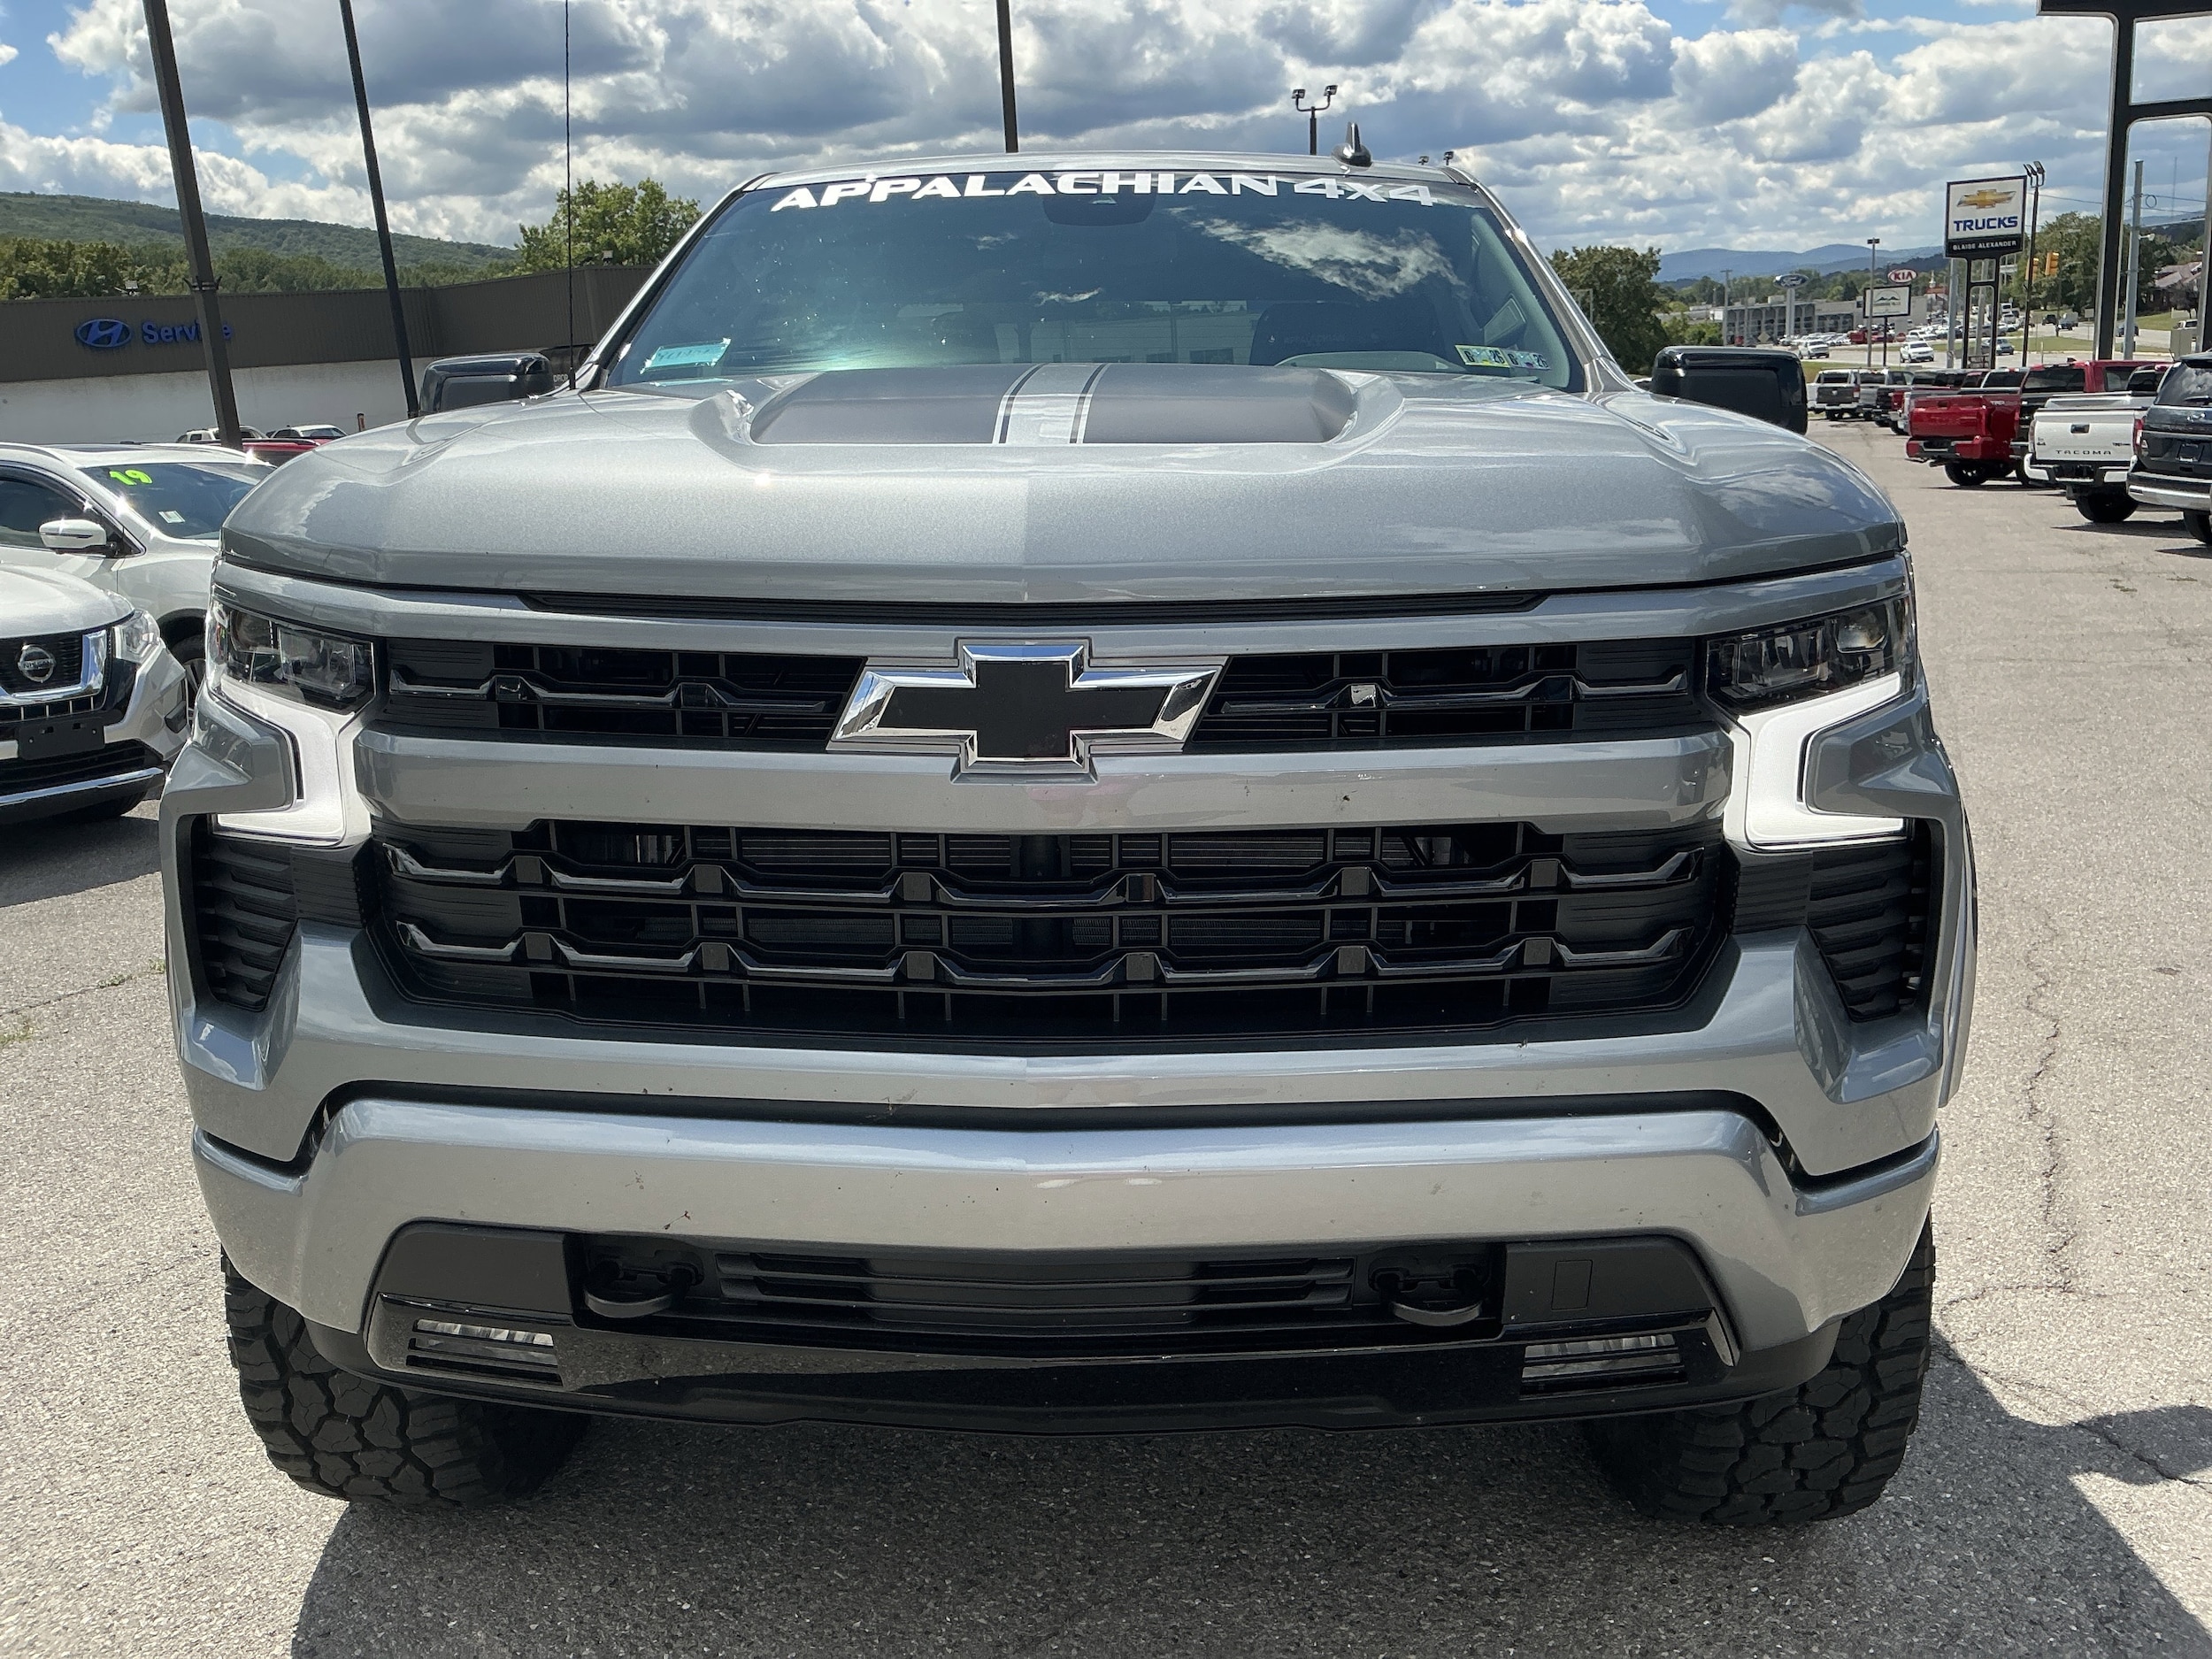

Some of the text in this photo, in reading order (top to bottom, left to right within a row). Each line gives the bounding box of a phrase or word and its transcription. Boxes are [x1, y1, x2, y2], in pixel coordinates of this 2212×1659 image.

[770, 173, 1279, 212] APPALACHIAN
[1953, 216, 2018, 232] TRUCKS
[1952, 240, 2017, 251] BLAISE ALEXANDER
[1893, 271, 1913, 280] KIA
[142, 319, 234, 344] Servie
[1489, 349, 1505, 364] 26
[1532, 353, 1549, 368] 26
[552, 373, 569, 383] DROP
[109, 470, 153, 486] 19
[23, 658, 53, 669] NISSAN
